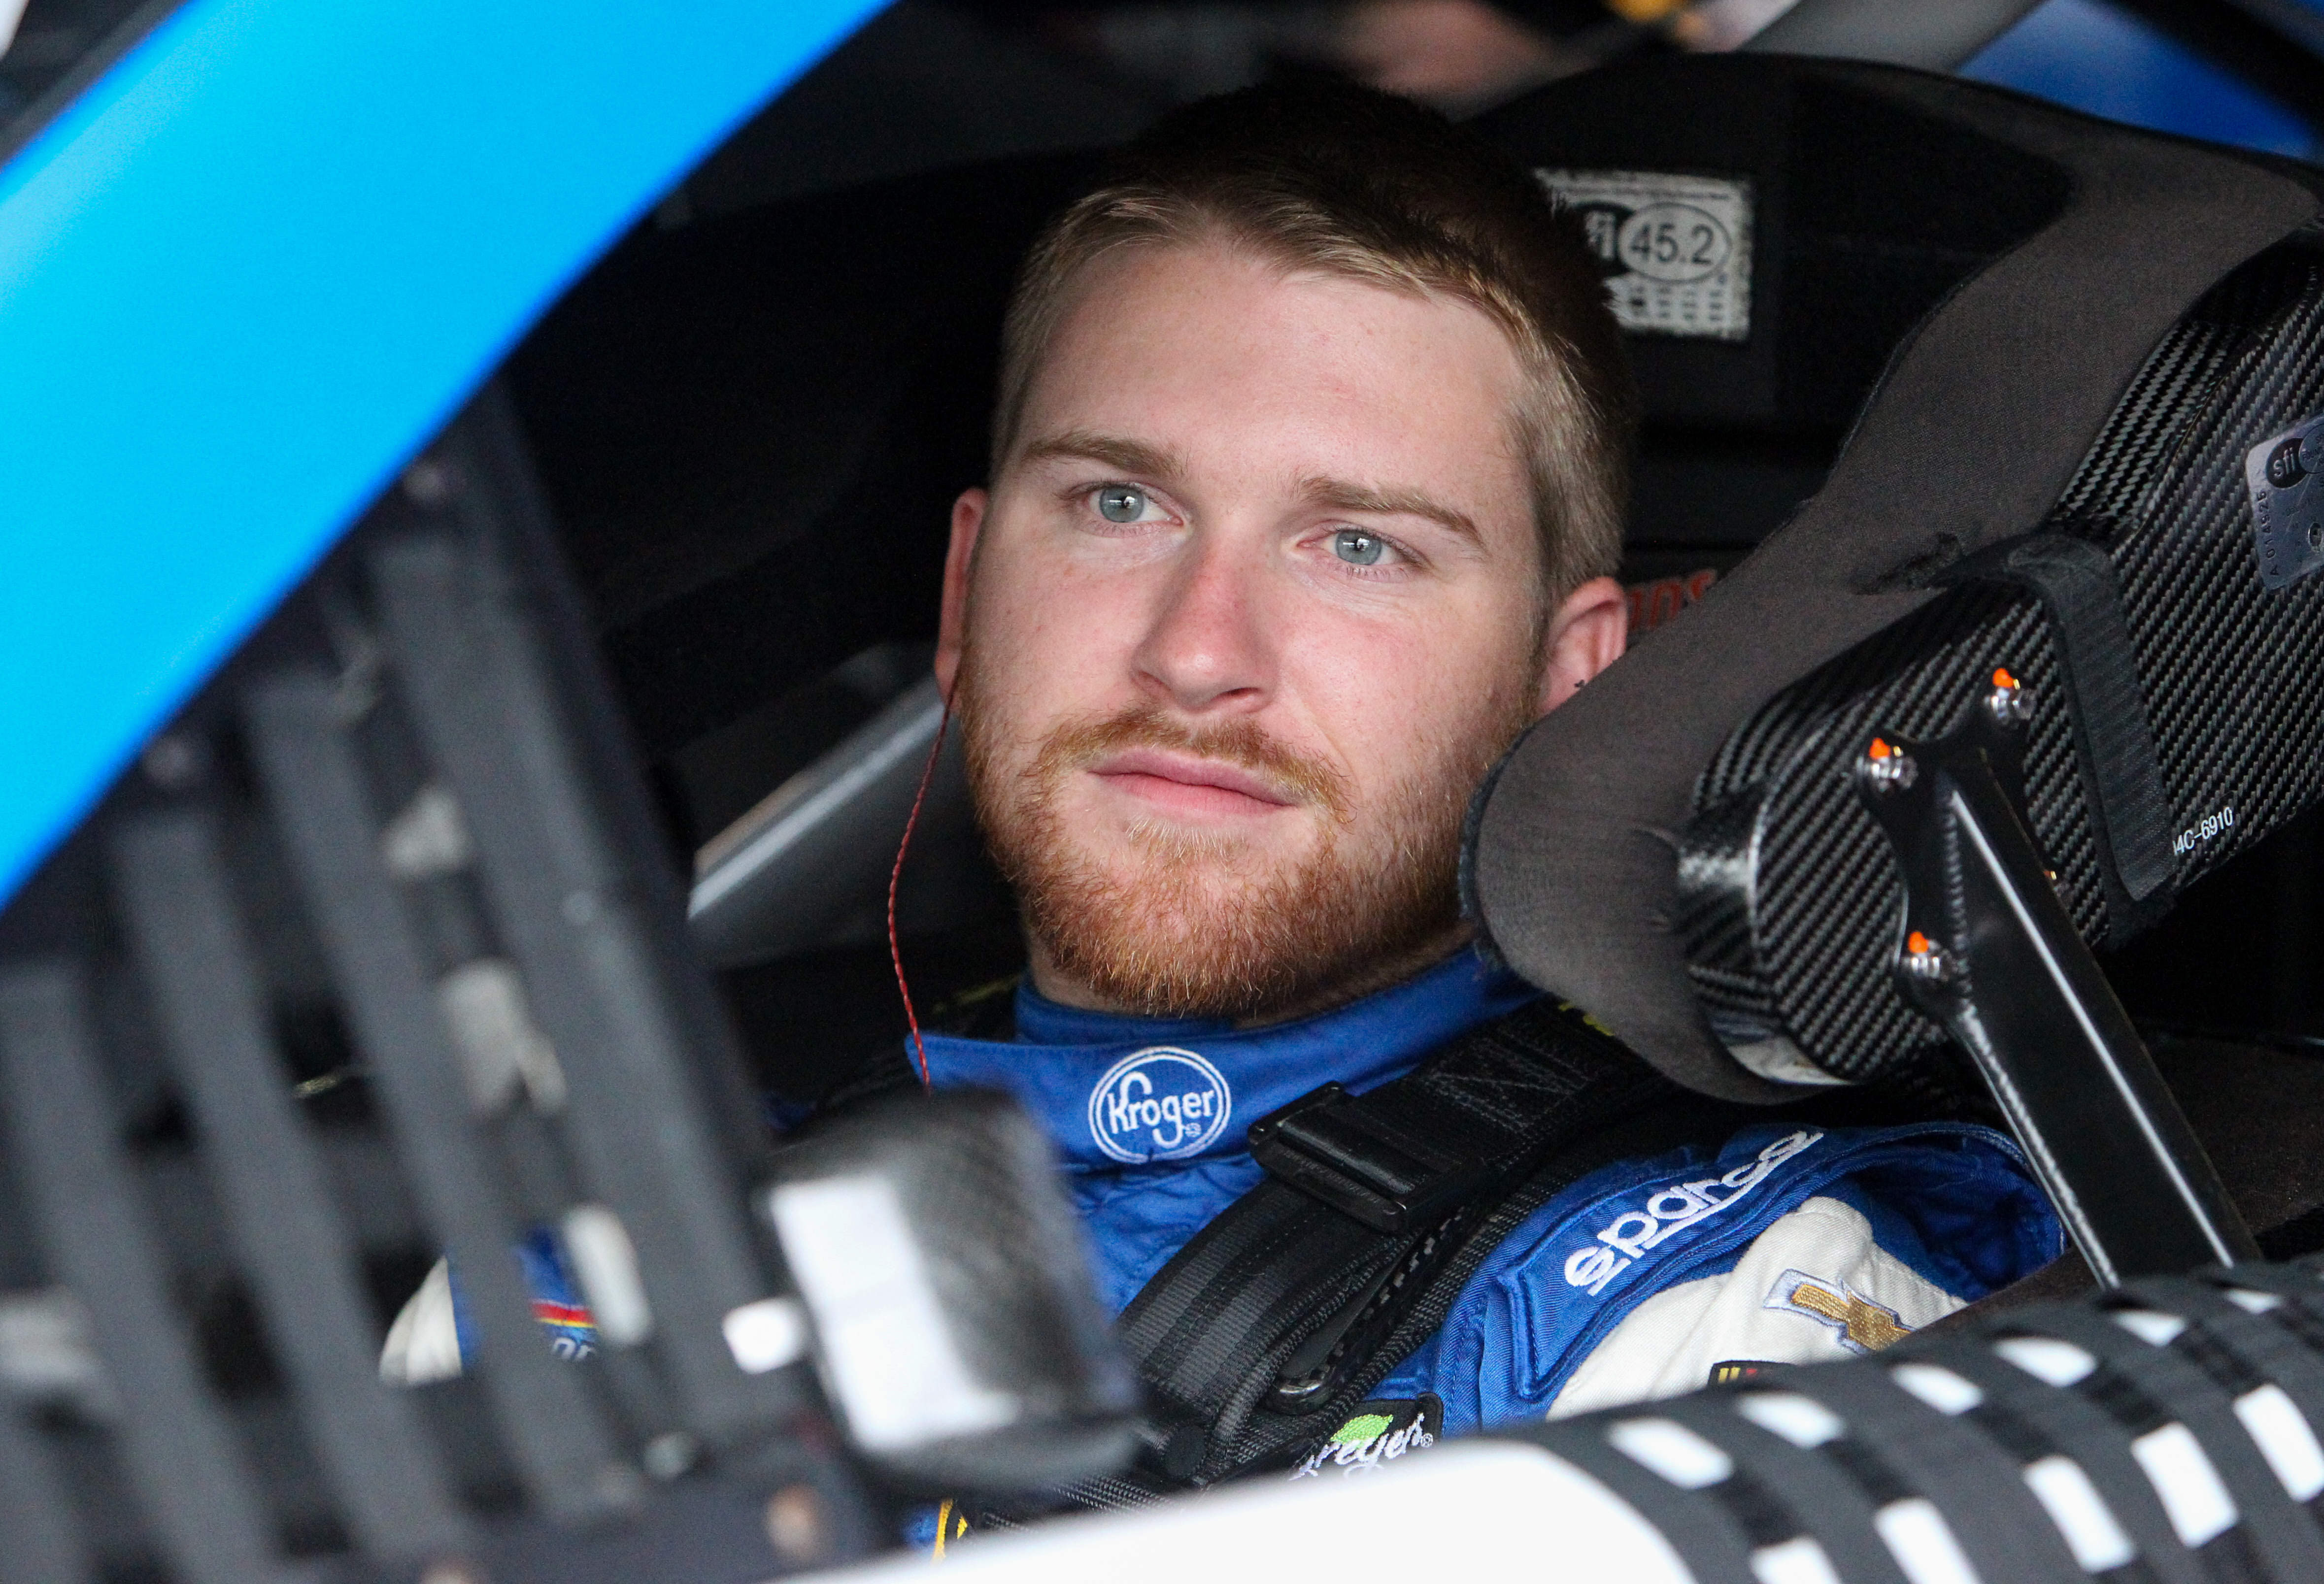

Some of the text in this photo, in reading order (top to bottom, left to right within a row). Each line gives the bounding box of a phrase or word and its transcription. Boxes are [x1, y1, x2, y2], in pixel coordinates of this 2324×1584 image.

[1630, 222, 1714, 265] 45.2
[2273, 446, 2296, 477] sfi
[1107, 1071, 1214, 1149] Kroger
[1564, 1130, 1818, 1291] sparco
